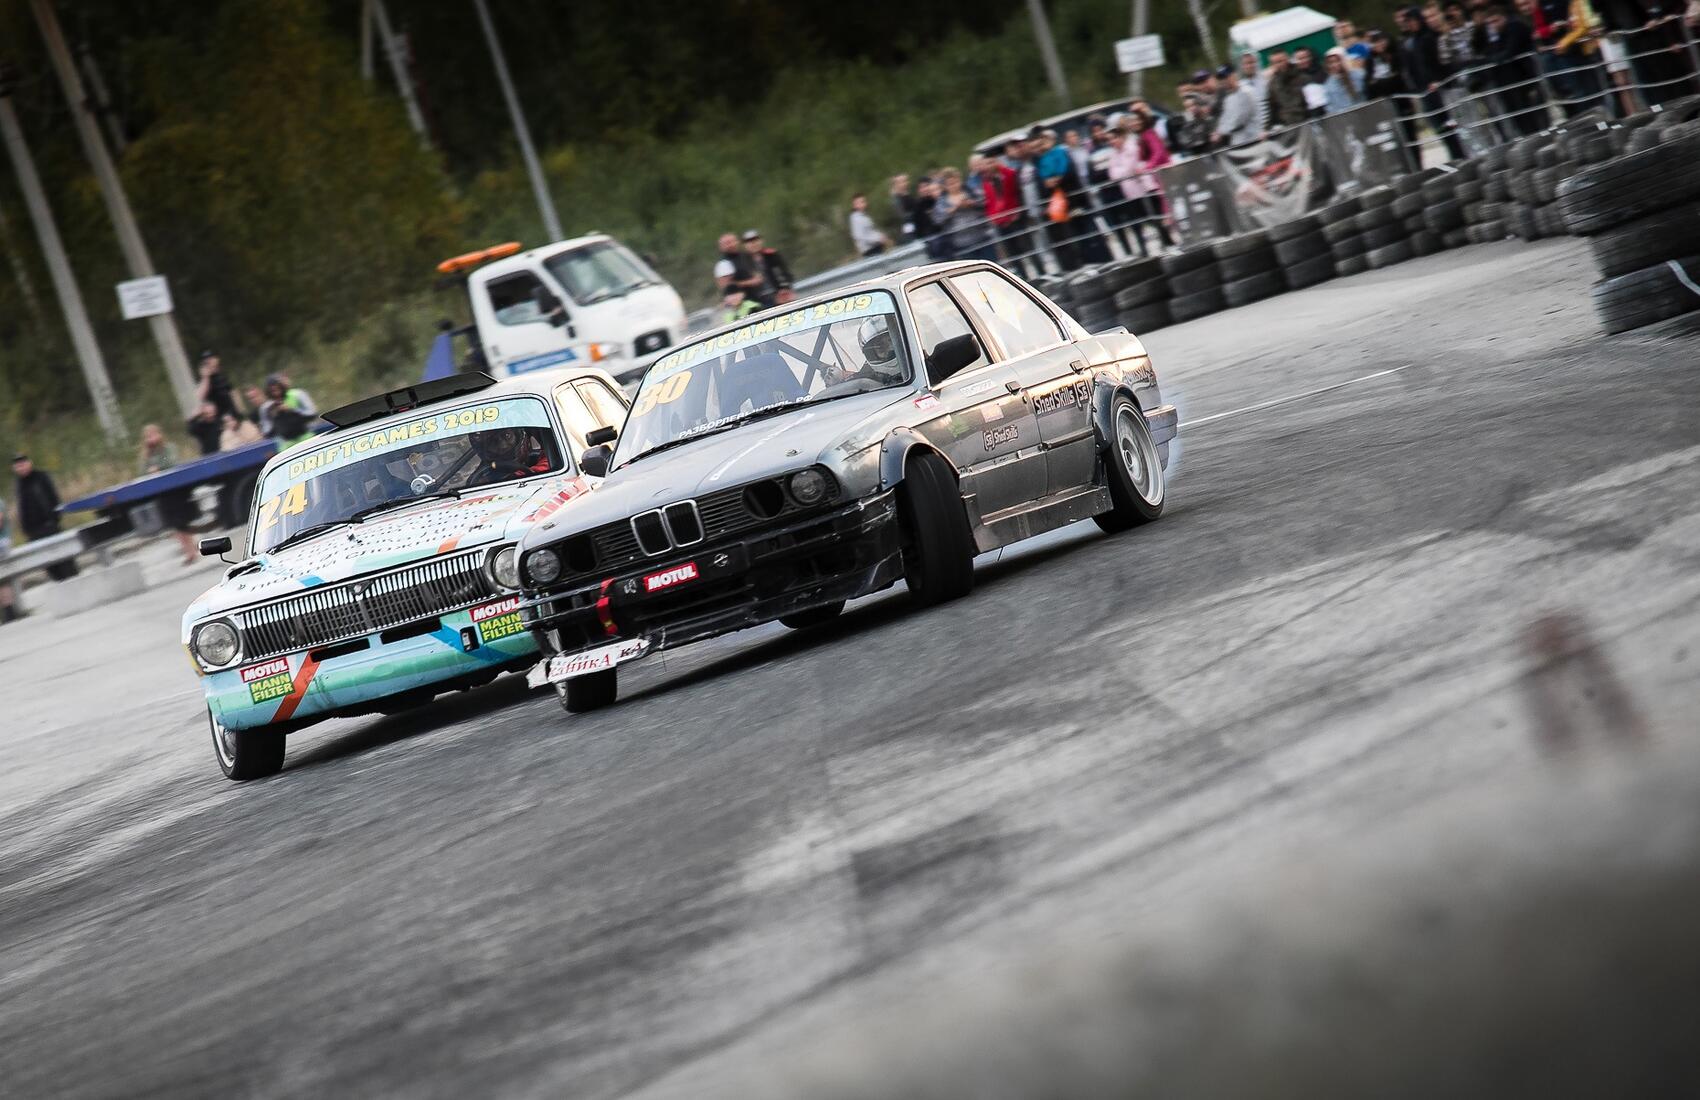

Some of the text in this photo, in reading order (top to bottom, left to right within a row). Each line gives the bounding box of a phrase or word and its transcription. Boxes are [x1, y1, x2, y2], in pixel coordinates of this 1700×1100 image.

[650, 294, 873, 376] DRIFTGAMES 2019
[633, 370, 693, 419] 30
[1054, 386, 1076, 408] Skills
[288, 406, 501, 479] DRIFTGAMES 2019
[257, 481, 308, 533] 24
[648, 565, 697, 591] MOTUL
[473, 598, 519, 621] MOTUL
[479, 613, 522, 632] MANN
[482, 623, 524, 641] FILTER
[243, 660, 288, 682] MOTUL
[250, 673, 290, 693] MANN
[252, 684, 293, 702] FILTER
